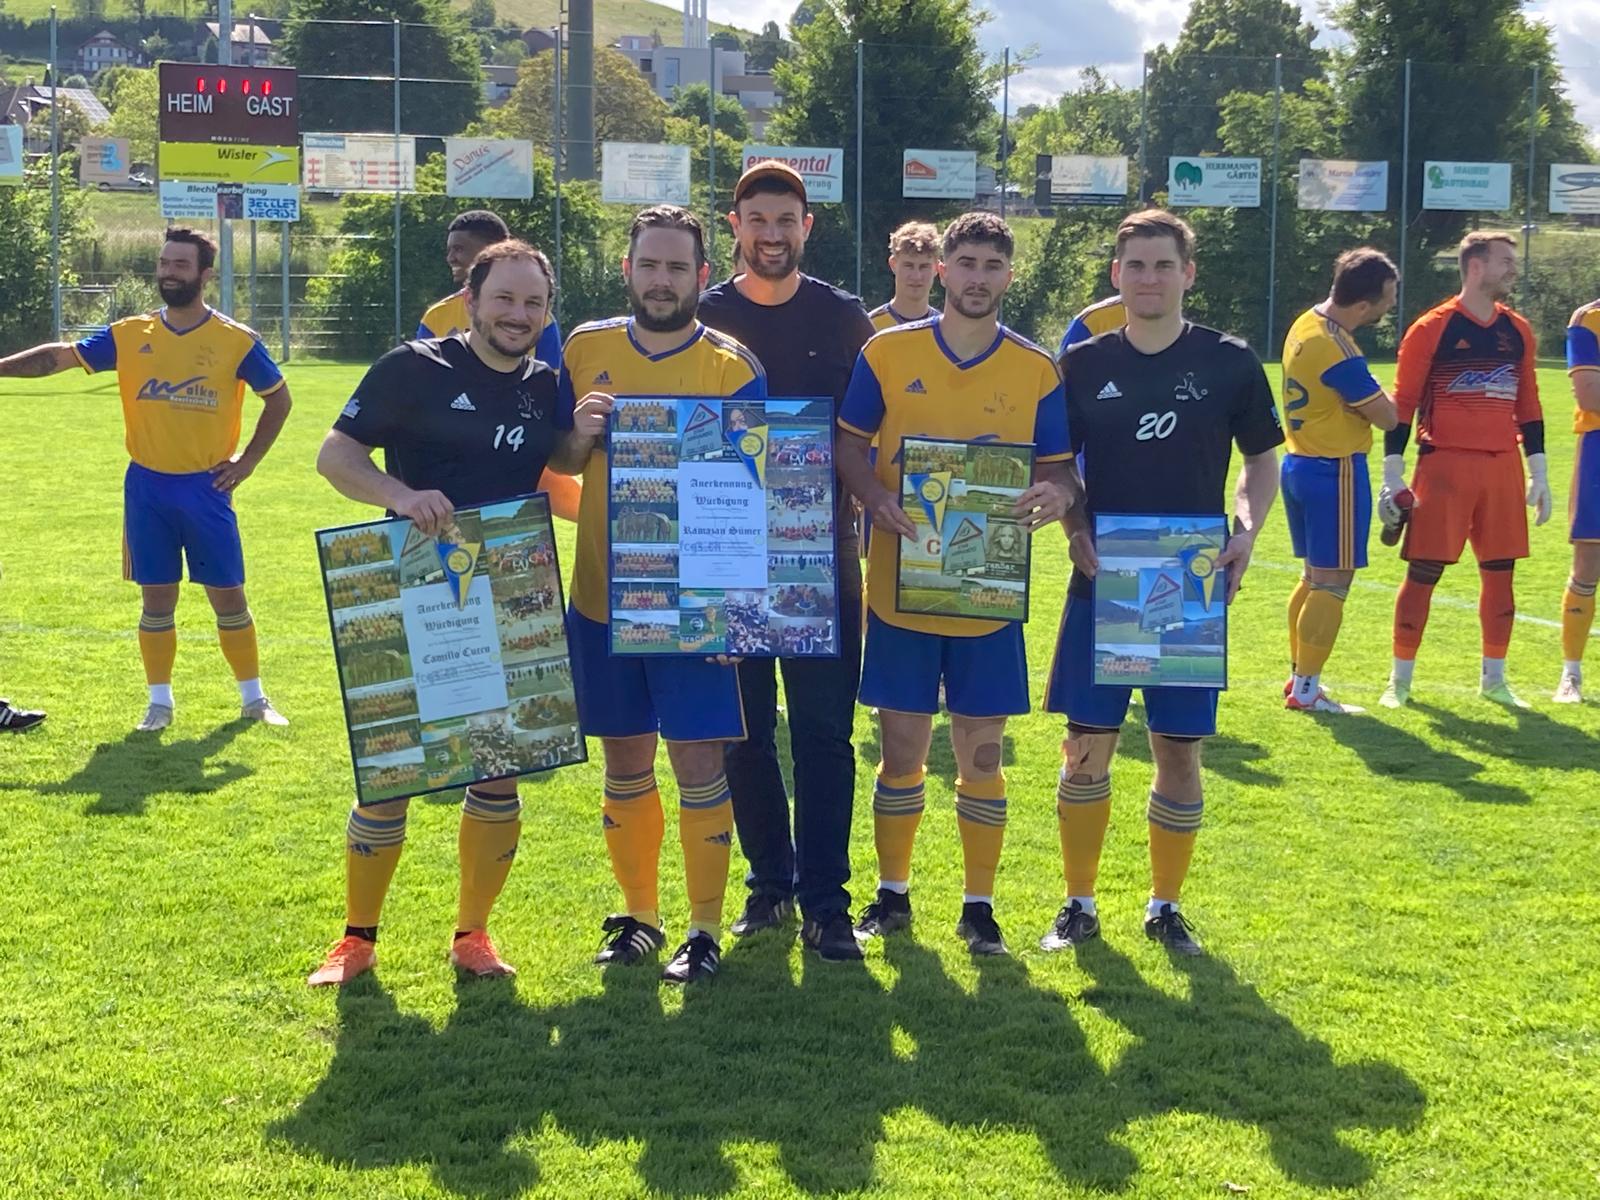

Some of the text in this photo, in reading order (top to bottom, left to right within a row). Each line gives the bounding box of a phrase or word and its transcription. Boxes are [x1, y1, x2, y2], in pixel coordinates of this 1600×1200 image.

[168, 93, 293, 116] HEIM GAST
[217, 148, 258, 160] Wisler
[187, 184, 268, 197] Blechbearbeitung
[247, 198, 297, 208] BETTLER
[1135, 411, 1178, 441] 20
[493, 424, 525, 452] 14
[689, 478, 753, 489] Anerkennung
[424, 616, 480, 631] Würdigung
[423, 650, 460, 664] Camillo
